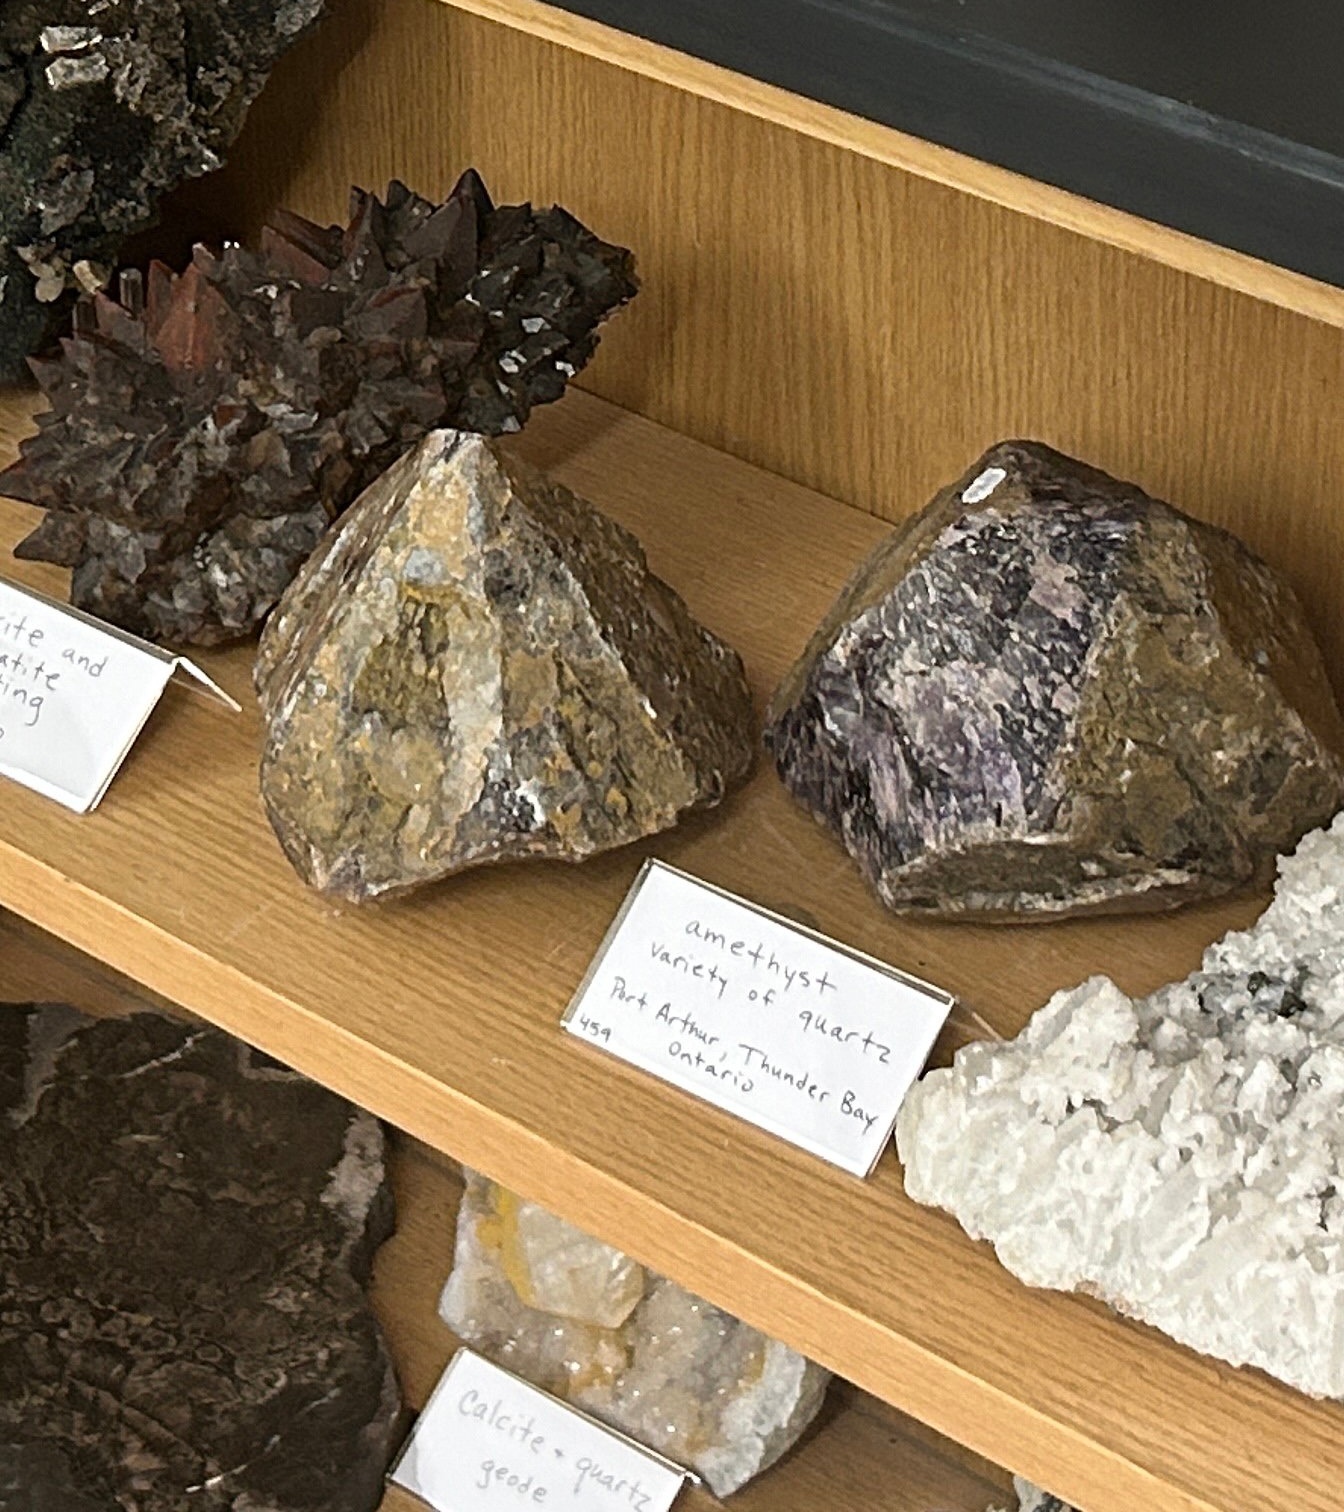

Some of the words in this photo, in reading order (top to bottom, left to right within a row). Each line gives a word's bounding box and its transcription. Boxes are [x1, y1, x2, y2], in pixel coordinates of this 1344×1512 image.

[62, 648, 107, 678] and
[685, 920, 838, 993] amethyst
[579, 1015, 612, 1042] 459
[651, 941, 728, 999] variety
[748, 987, 775, 1006] of
[799, 1010, 892, 1065] quartz
[610, 976, 647, 1010] Port
[738, 1042, 830, 1102] Thunder
[839, 1090, 879, 1136] Bay
[668, 1040, 755, 1093] Ontario
[458, 1390, 546, 1454] Calcite
[575, 1455, 653, 1512] quartz
[476, 1458, 547, 1503] geode
